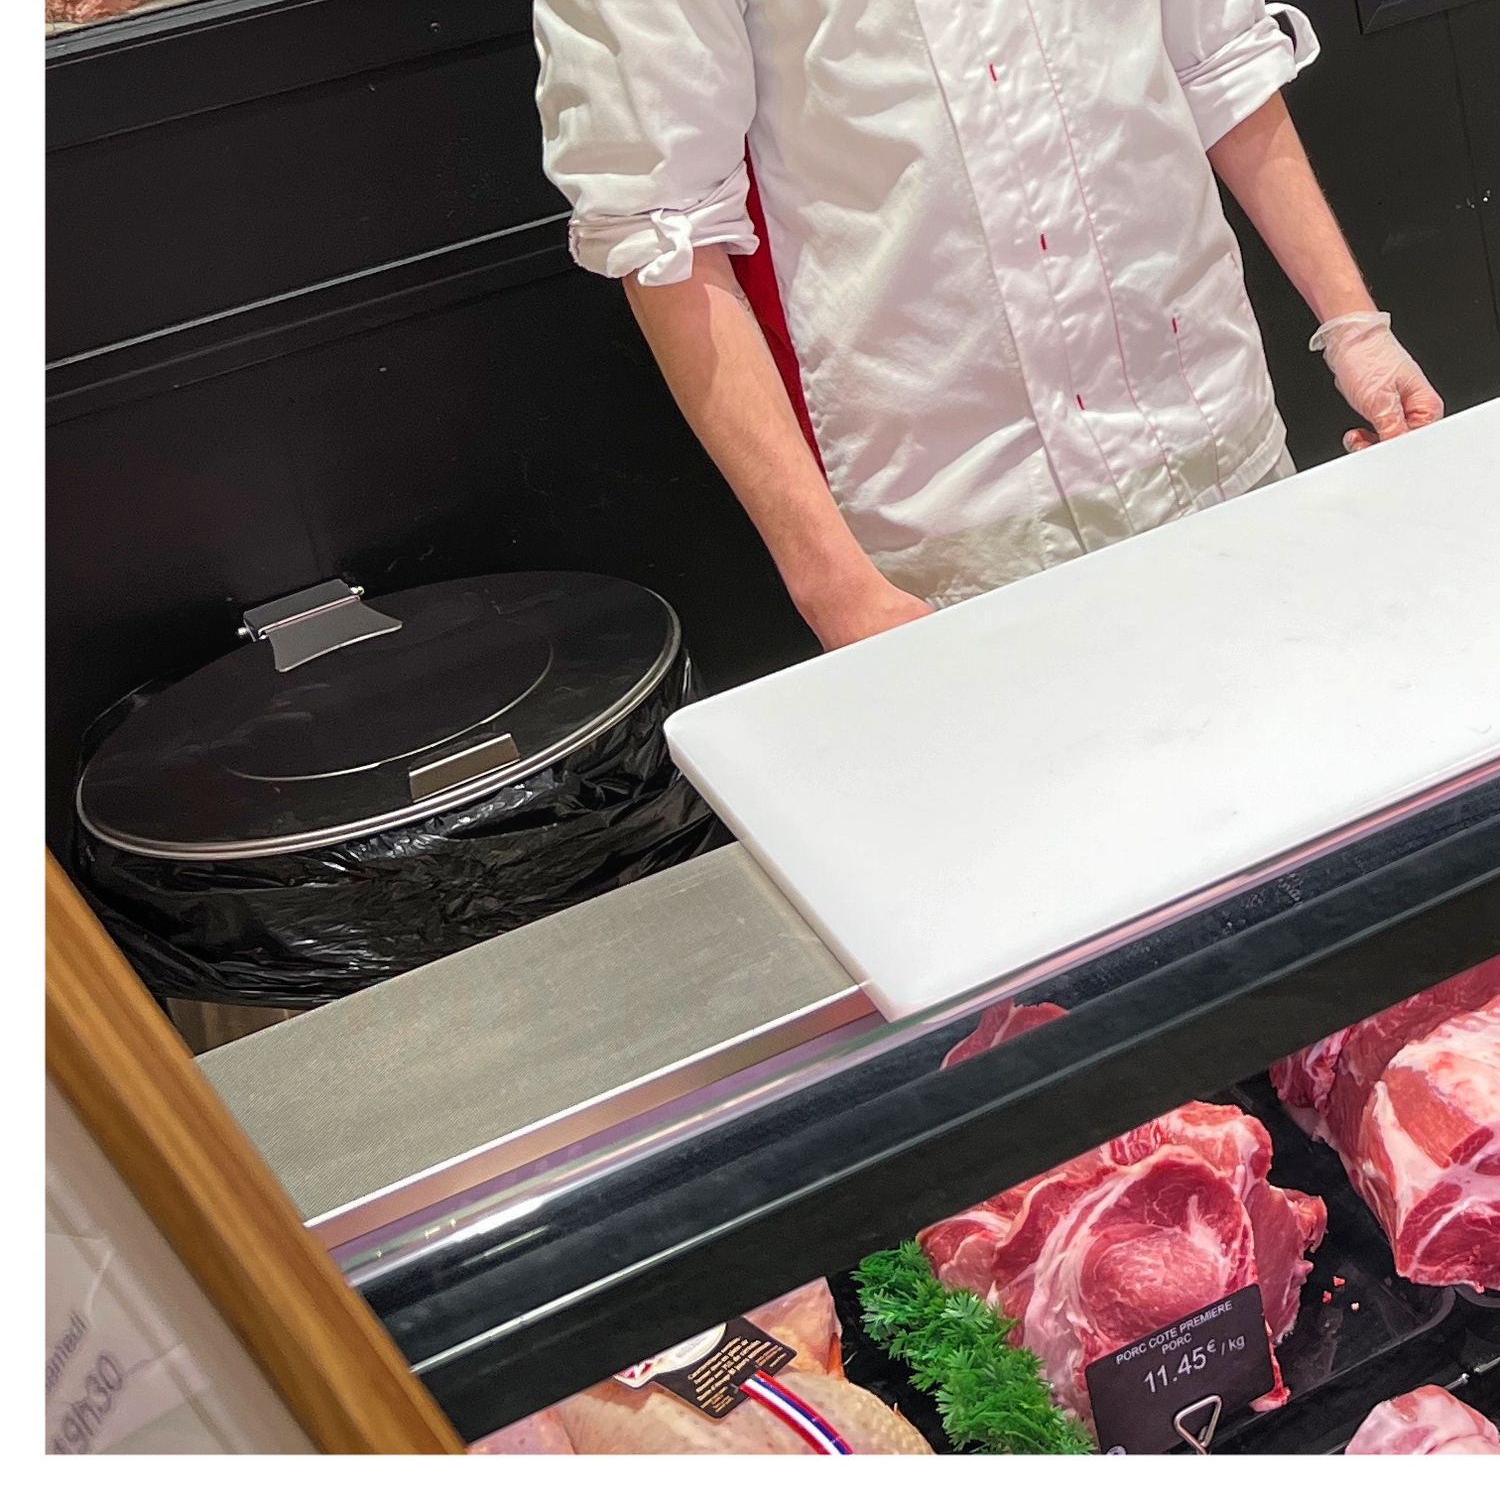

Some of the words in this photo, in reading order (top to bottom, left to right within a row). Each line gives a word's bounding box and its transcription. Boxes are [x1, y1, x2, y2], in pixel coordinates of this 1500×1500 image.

[1115, 1342, 1147, 1365] PORC
[1148, 1328, 1179, 1349] COTE
[1179, 1300, 1233, 1334] PREMIERE
[1161, 1332, 1192, 1355] PORC
[1228, 1334, 1245, 1351] kg
